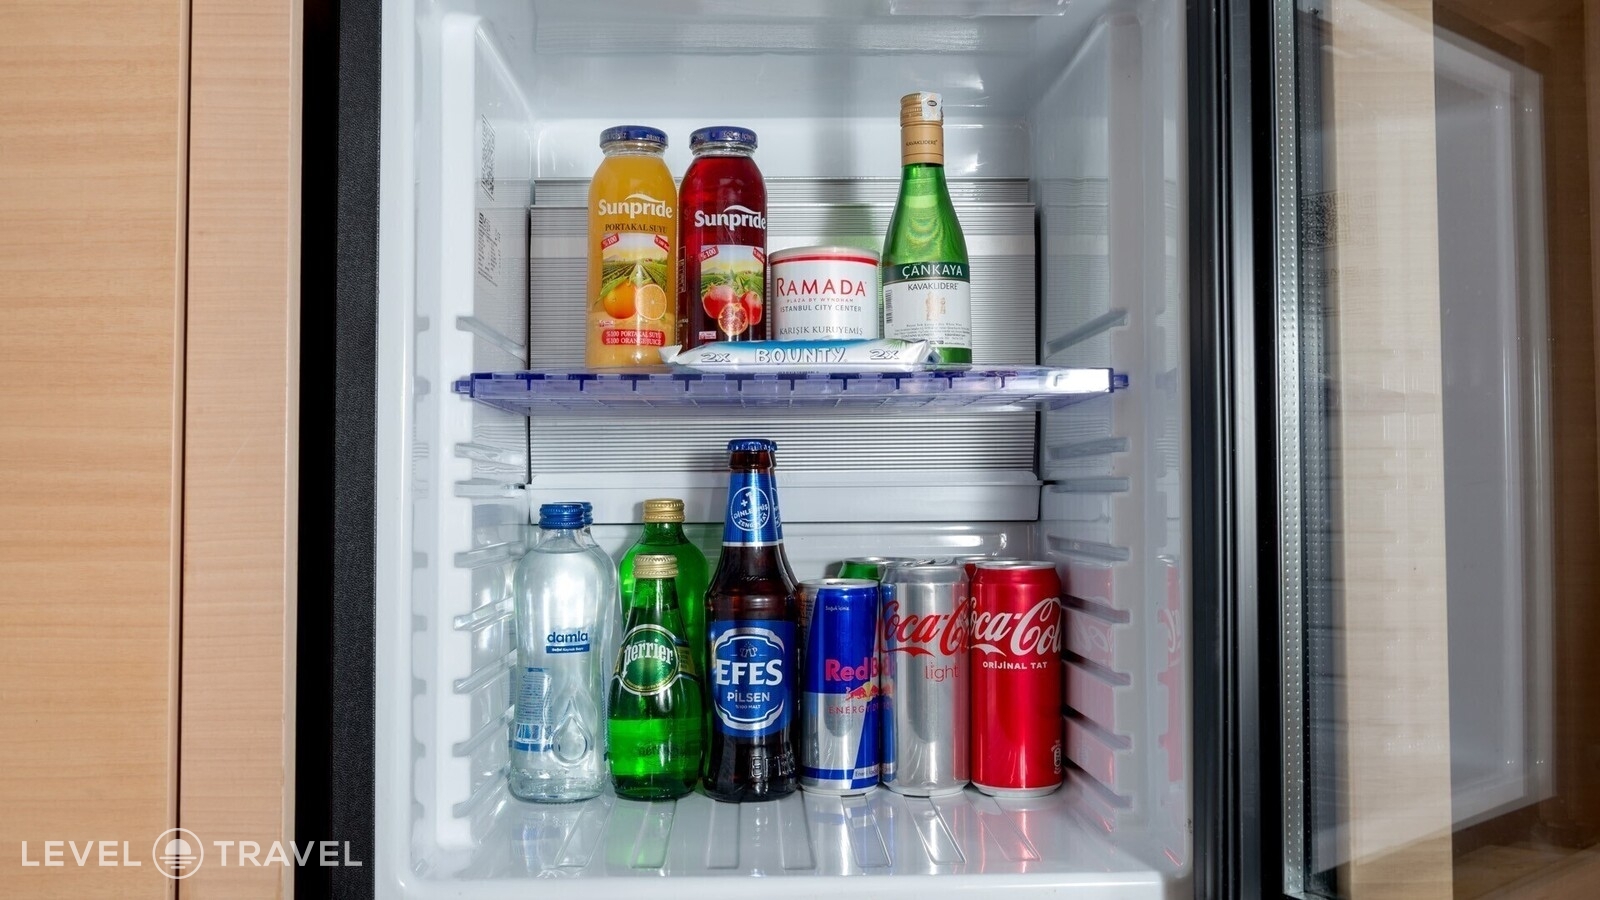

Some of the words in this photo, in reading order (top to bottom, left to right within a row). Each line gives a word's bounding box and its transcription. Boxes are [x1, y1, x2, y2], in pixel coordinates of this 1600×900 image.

[598, 195, 673, 219] Sunpride
[694, 206, 766, 231] Sunpride
[605, 223, 647, 232] PORTAKAL
[902, 263, 963, 279] ÇANKAYA
[776, 277, 866, 297] RAMADA
[907, 282, 958, 291] KAVAKLIDERE
[835, 304, 862, 312] CENTER
[755, 347, 845, 364] BOUNTY
[547, 630, 588, 643] damla
[716, 659, 783, 686] EFES
[825, 656, 869, 682] Red
[925, 662, 960, 682] light
[982, 661, 1028, 670] ORİJİNAL
[1030, 661, 1048, 669] TAT
[727, 689, 770, 702] PİLSEN
